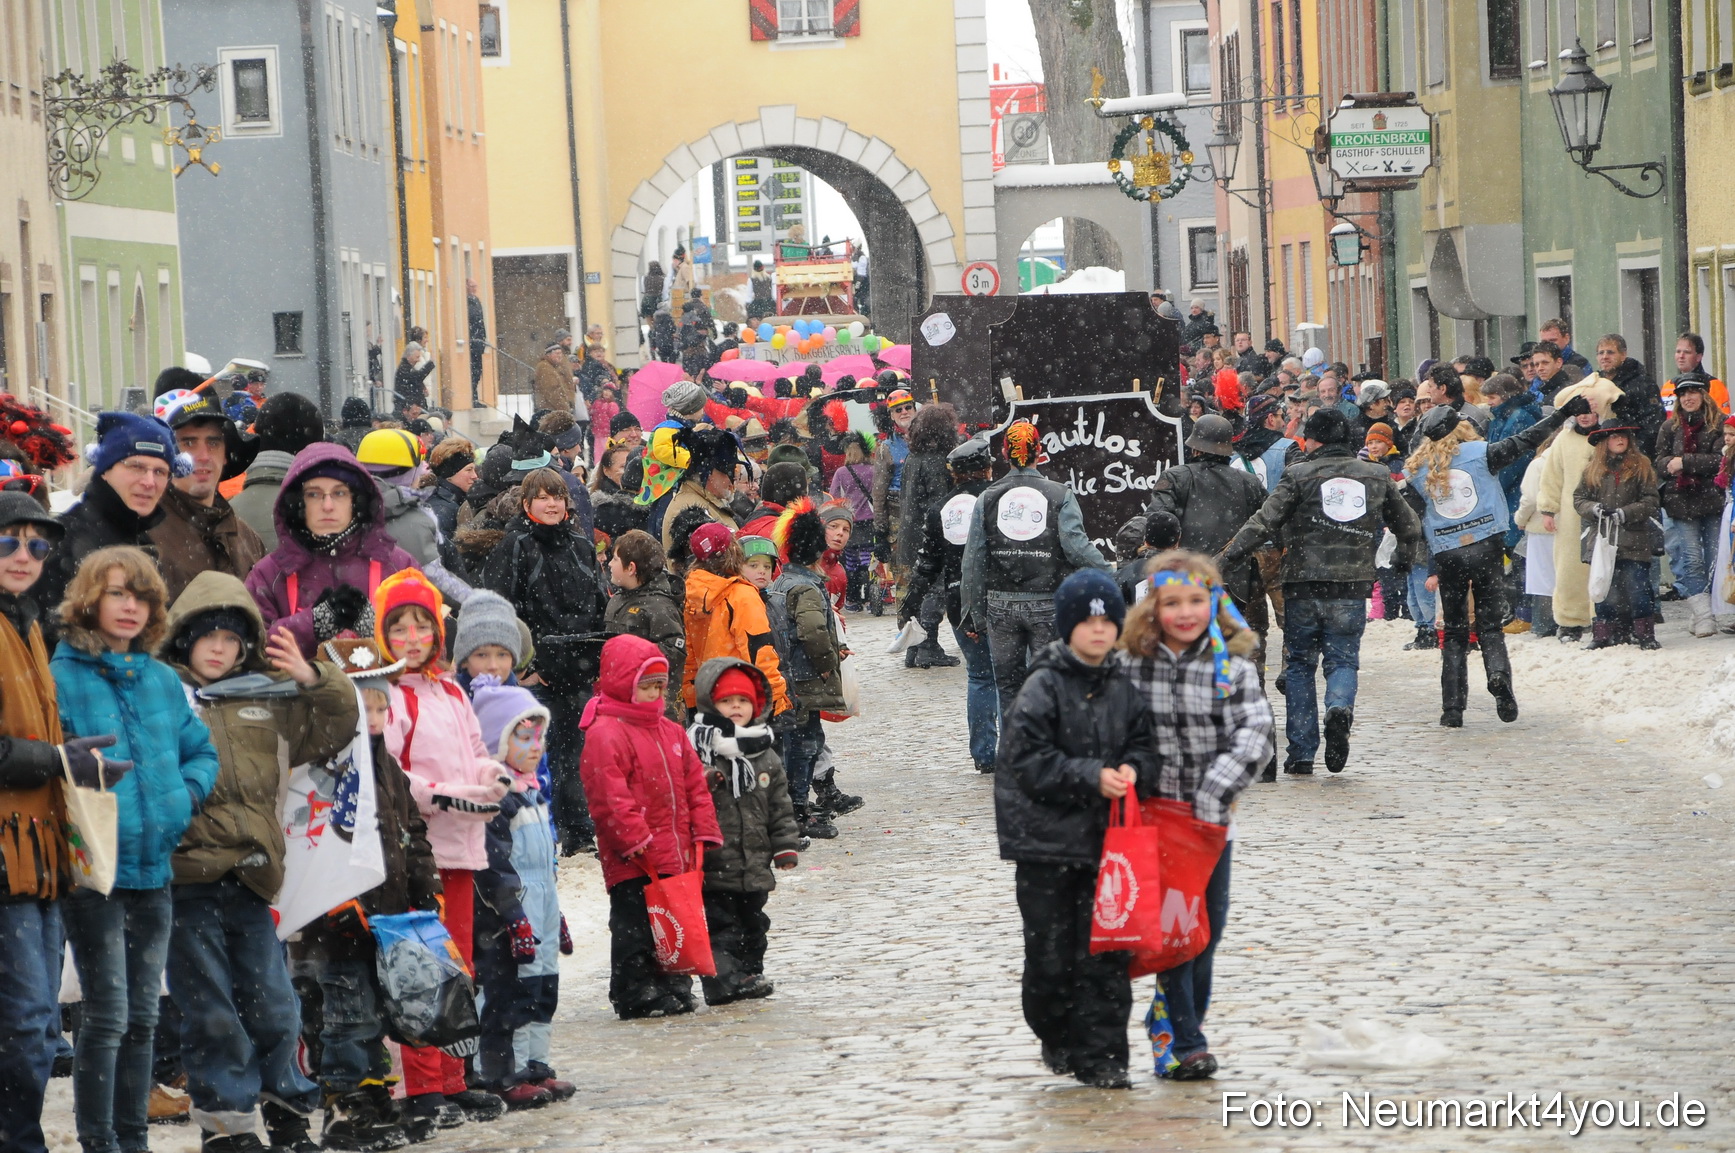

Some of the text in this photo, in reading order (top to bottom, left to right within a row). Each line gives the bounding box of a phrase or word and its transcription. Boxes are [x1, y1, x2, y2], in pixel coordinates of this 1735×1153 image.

[1016, 125, 1034, 140] 30
[1335, 132, 1425, 146] KRONENBRÄU
[1016, 149, 1037, 158] ZONE
[1336, 149, 1375, 158] GASTHOF
[972, 274, 990, 288] 3 m
[1035, 406, 1142, 457] autlos
[1065, 467, 1098, 496] die
